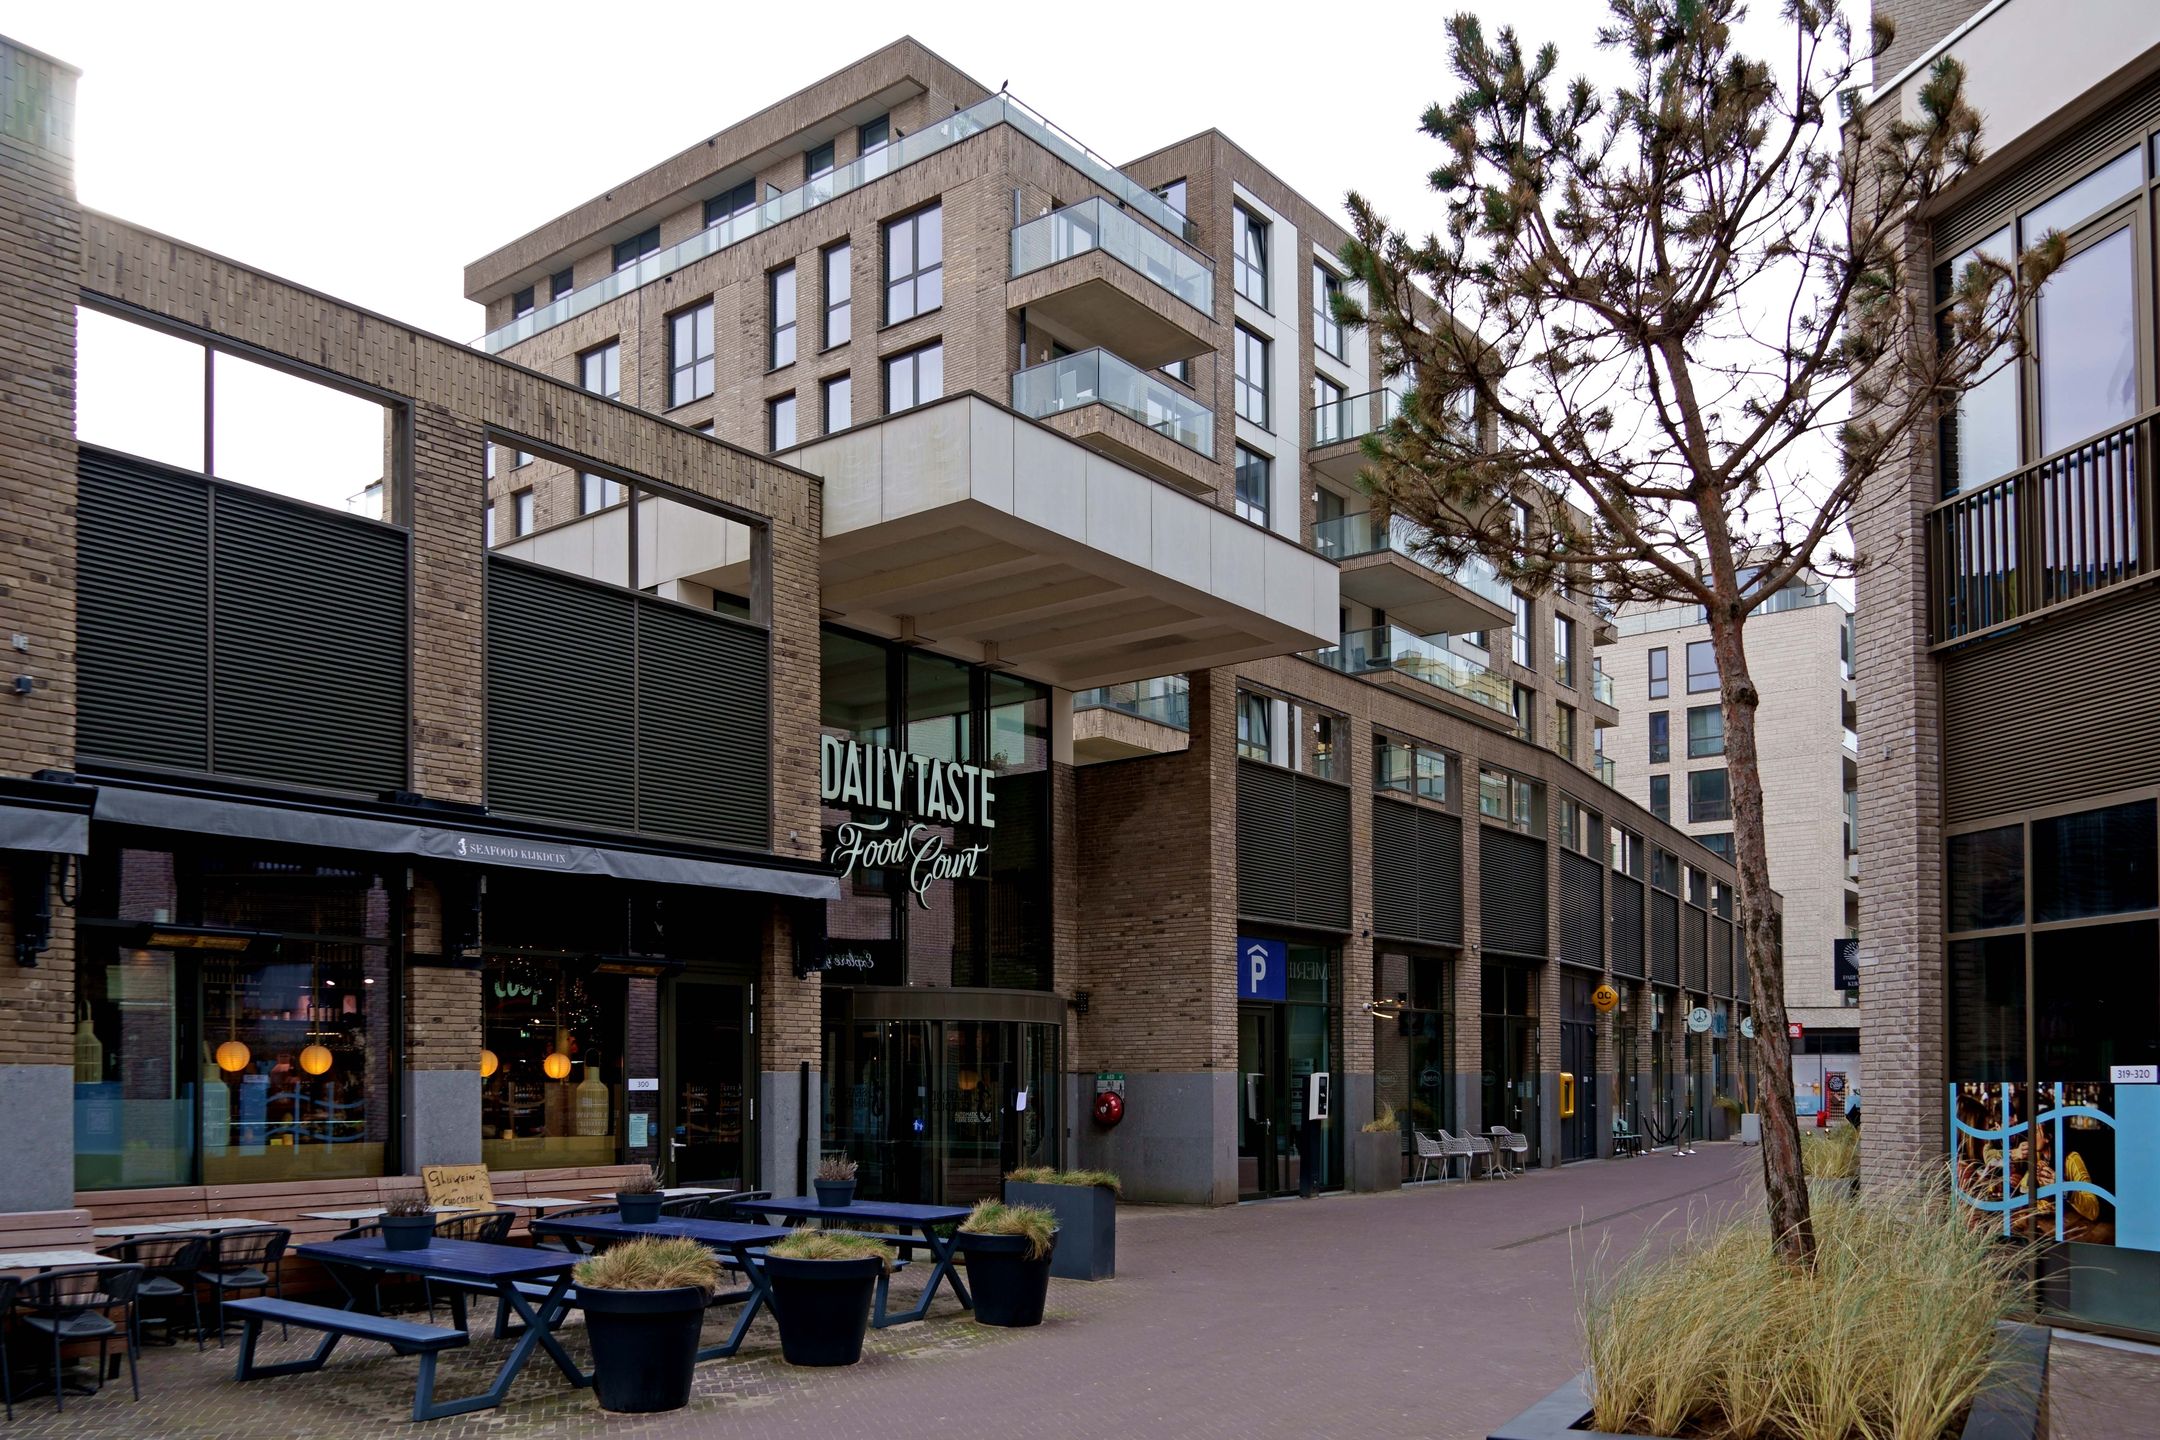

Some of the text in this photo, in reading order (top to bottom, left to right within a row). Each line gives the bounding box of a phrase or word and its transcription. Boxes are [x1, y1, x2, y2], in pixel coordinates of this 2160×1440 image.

[820, 733, 996, 829] DAILY TASTE
[470, 843, 518, 859] SEAFOOD
[830, 817, 990, 911] Food Court
[1251, 954, 1267, 994] P
[637, 1080, 650, 1088] 300
[2117, 1069, 2151, 1079] 319-320
